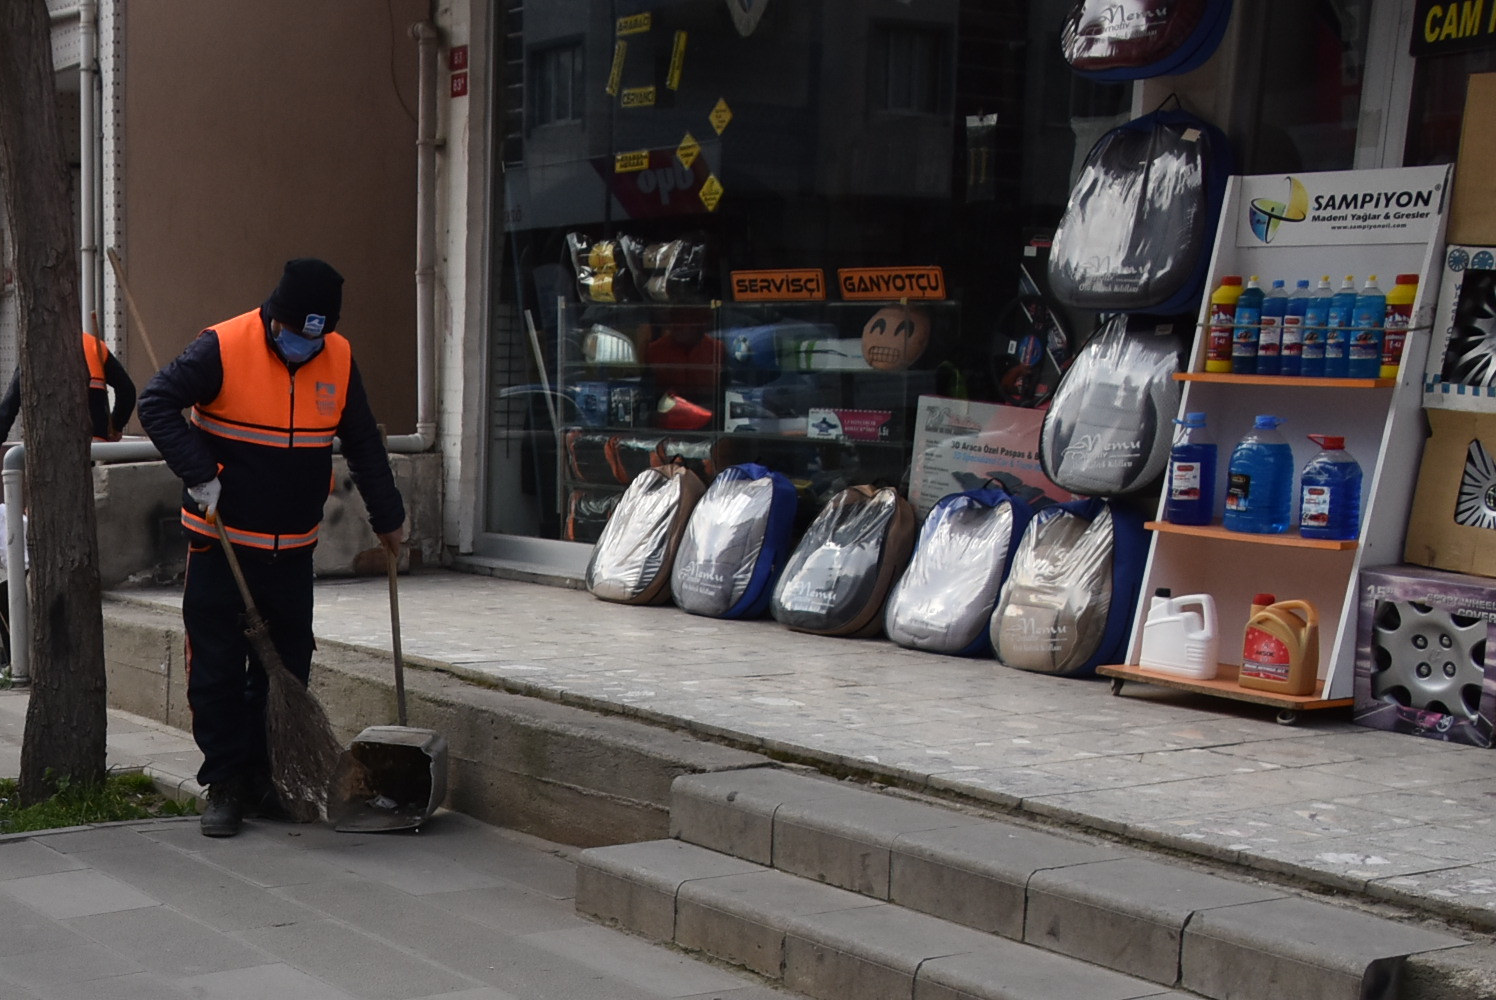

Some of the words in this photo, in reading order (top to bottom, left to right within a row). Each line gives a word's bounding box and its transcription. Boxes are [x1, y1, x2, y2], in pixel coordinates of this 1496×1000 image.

[1424, 0, 1485, 43] CAM
[1311, 213, 1348, 222] Madeni
[1351, 212, 1381, 222] Yağlar
[1383, 211, 1390, 220] &
[1392, 211, 1431, 220] Gresler
[843, 273, 939, 297] GANYOTÇU
[961, 442, 982, 452] Araca
[1000, 447, 1025, 459] Paspas
